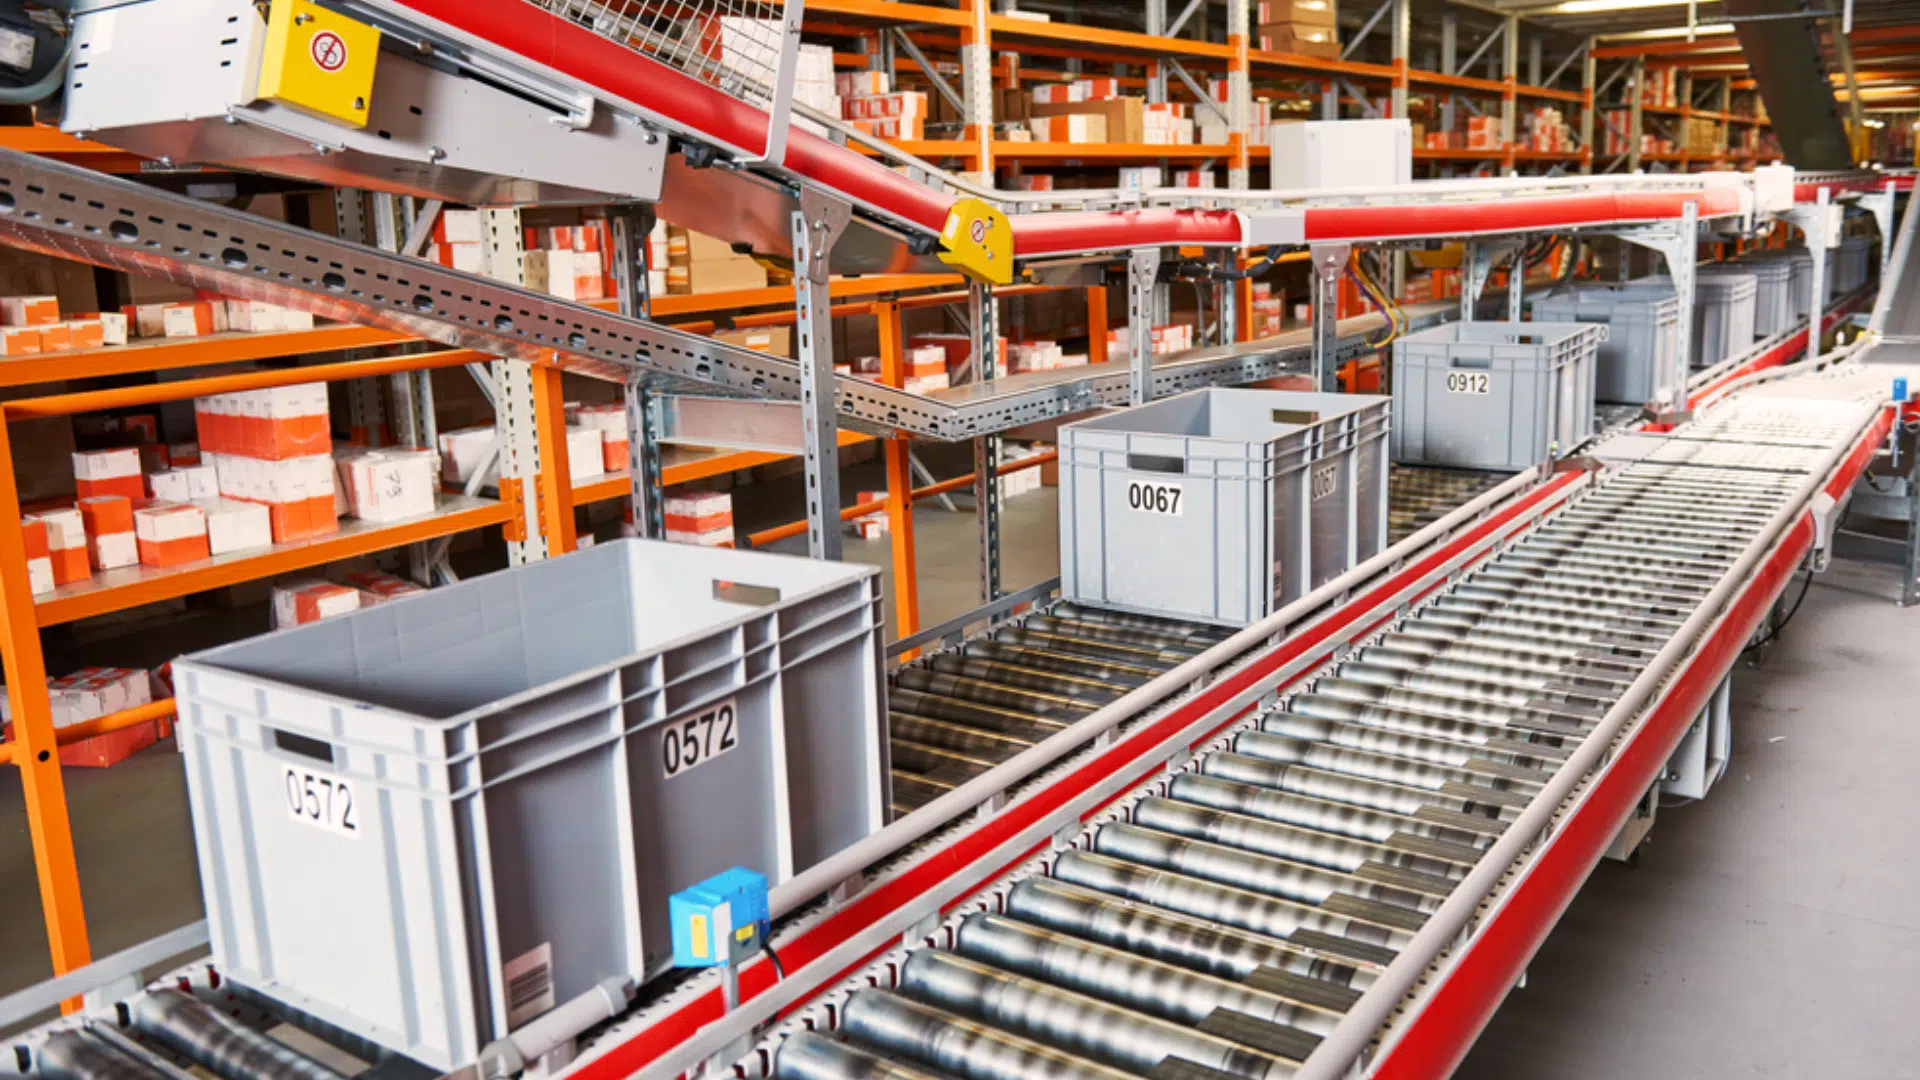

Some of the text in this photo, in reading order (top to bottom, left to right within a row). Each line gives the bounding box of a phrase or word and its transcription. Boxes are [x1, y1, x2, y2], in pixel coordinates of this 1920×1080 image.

[1447, 373, 1487, 393] 0912
[1129, 482, 1181, 514] 0067
[664, 705, 735, 774] 0572
[286, 769, 356, 831] 0572
